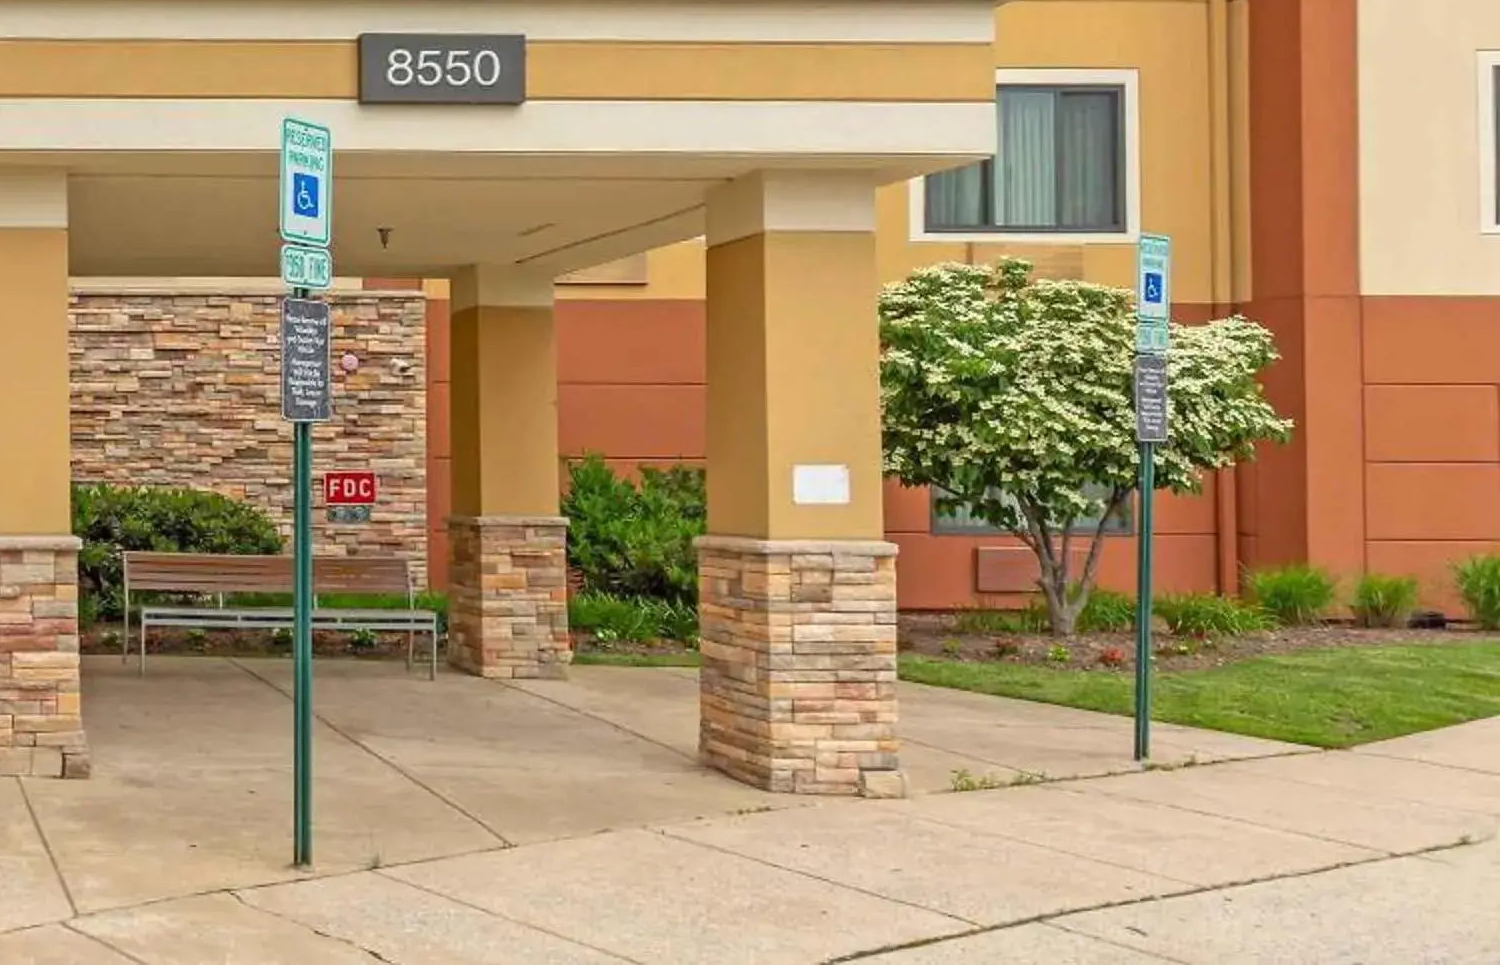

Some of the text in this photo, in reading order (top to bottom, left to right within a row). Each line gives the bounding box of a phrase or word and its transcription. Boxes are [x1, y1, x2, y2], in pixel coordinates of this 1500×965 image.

[387, 49, 500, 86] 8550
[289, 150, 325, 172] PARKING
[330, 478, 371, 497] FDC
